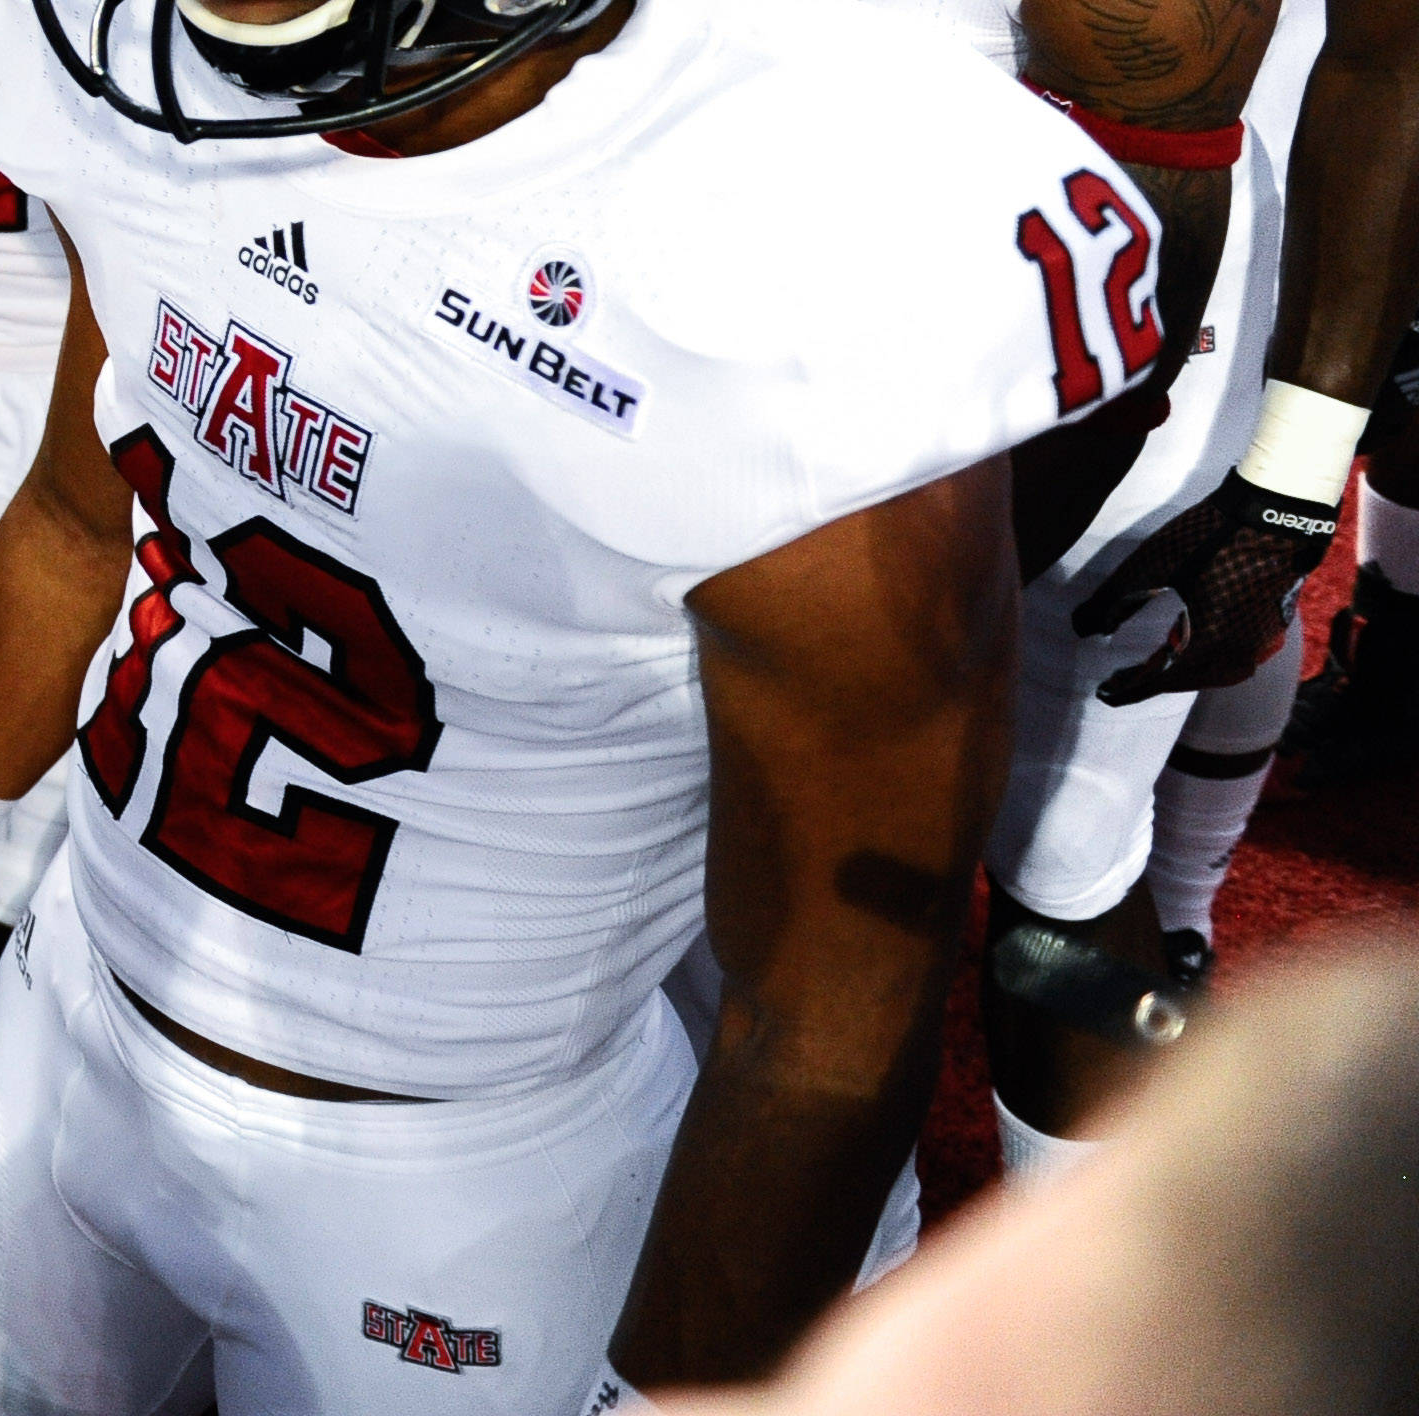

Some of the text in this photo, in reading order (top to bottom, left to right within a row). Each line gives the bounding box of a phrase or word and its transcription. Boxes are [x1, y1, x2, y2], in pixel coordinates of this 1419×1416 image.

[238, 245, 320, 305] adidas
[1016, 167, 1164, 419] 12
[148, 297, 373, 517] STATE
[435, 288, 637, 418] SUN BELT
[1262, 508, 1336, 536] adizero
[77, 422, 445, 956] 12
[363, 1300, 502, 1375] STATE
